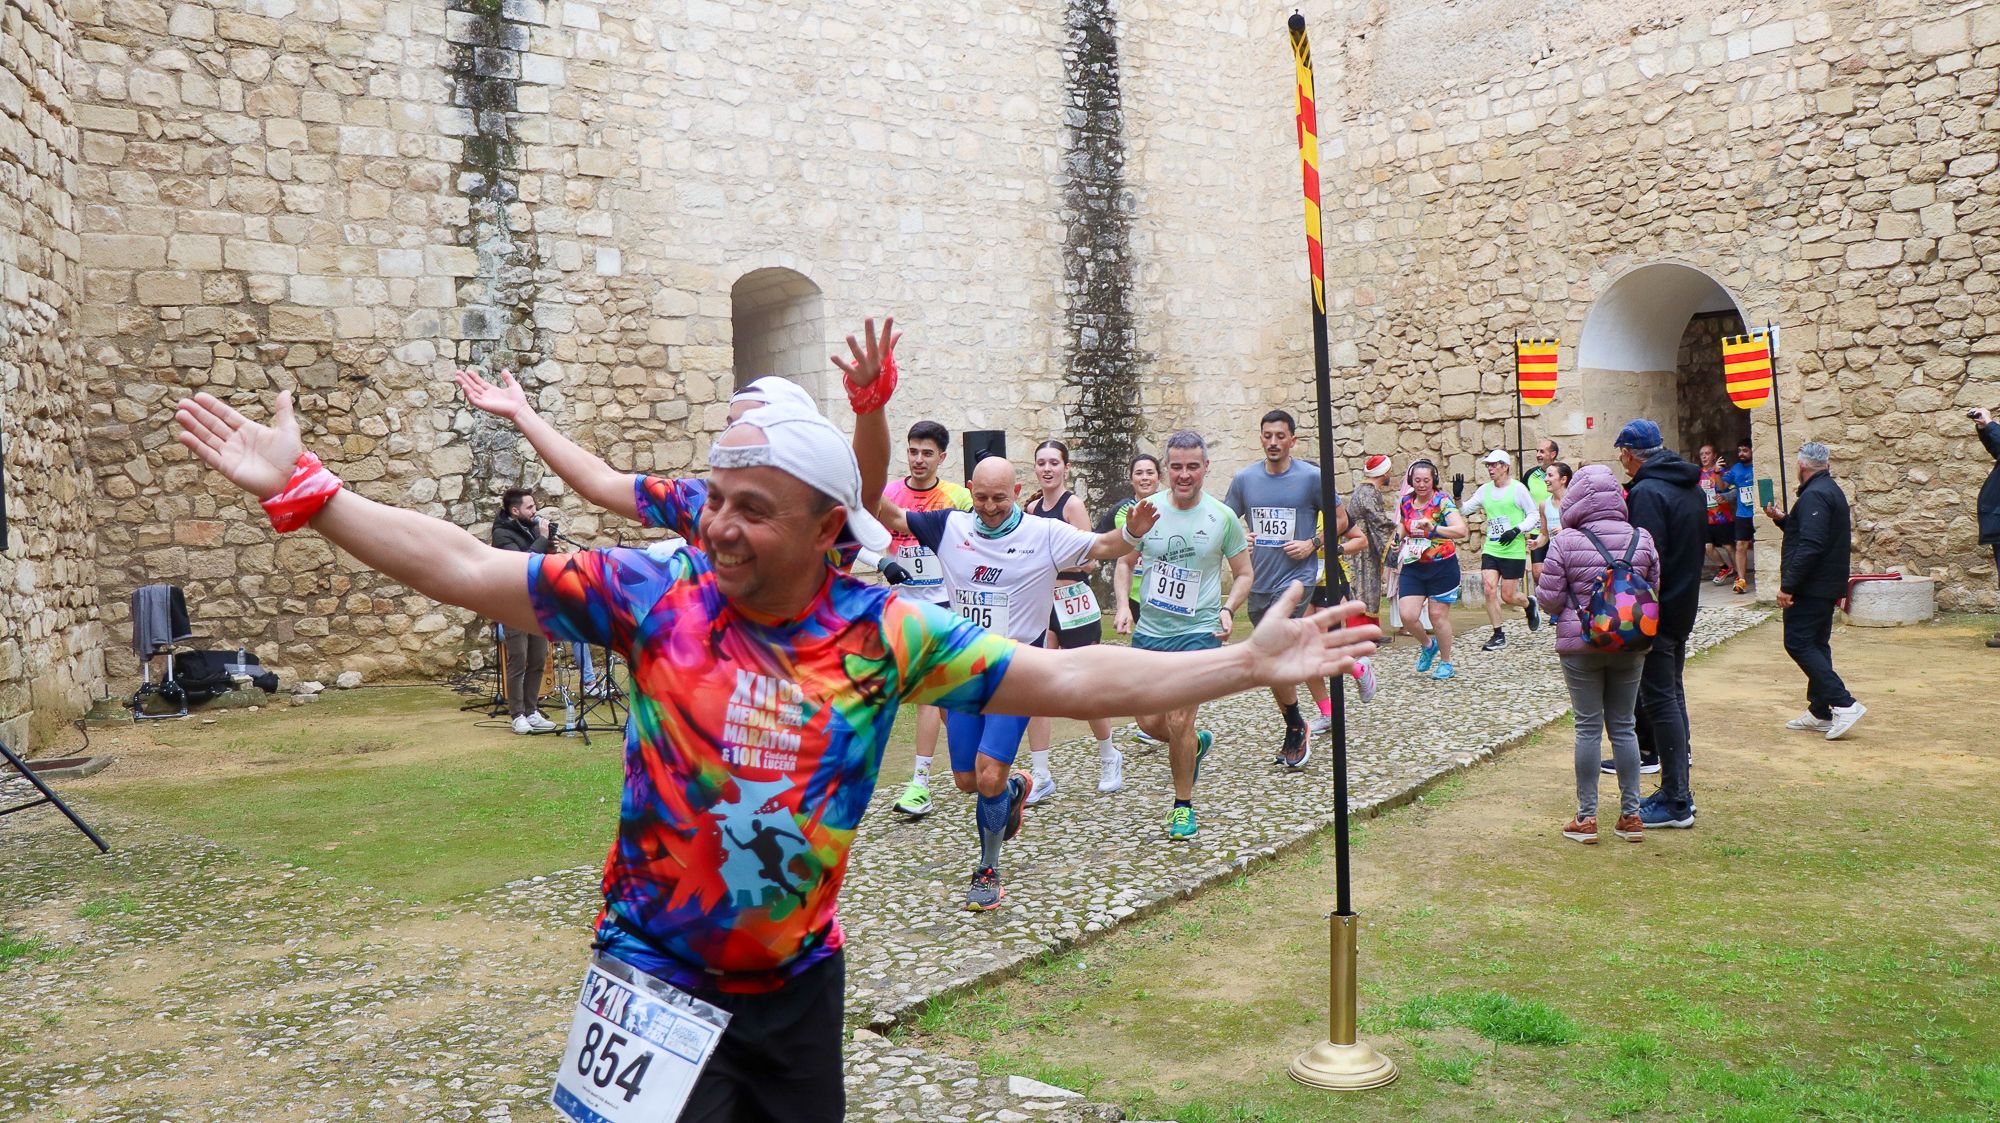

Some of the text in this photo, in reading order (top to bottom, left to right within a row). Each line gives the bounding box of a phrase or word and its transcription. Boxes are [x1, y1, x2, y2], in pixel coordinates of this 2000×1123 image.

[1259, 520, 1287, 535] 1453
[914, 558, 923, 574] 9
[1157, 577, 1186, 600] 919
[1065, 594, 1090, 615] 578
[730, 668, 777, 711] XII
[726, 703, 777, 731] MEDIA
[723, 722, 801, 752] MARATÓN
[721, 745, 762, 768] & 10K
[763, 758, 796, 771] LUCENA
[764, 750, 787, 760] Ciudad
[589, 977, 633, 1025] 21K
[578, 1022, 654, 1103] 854
